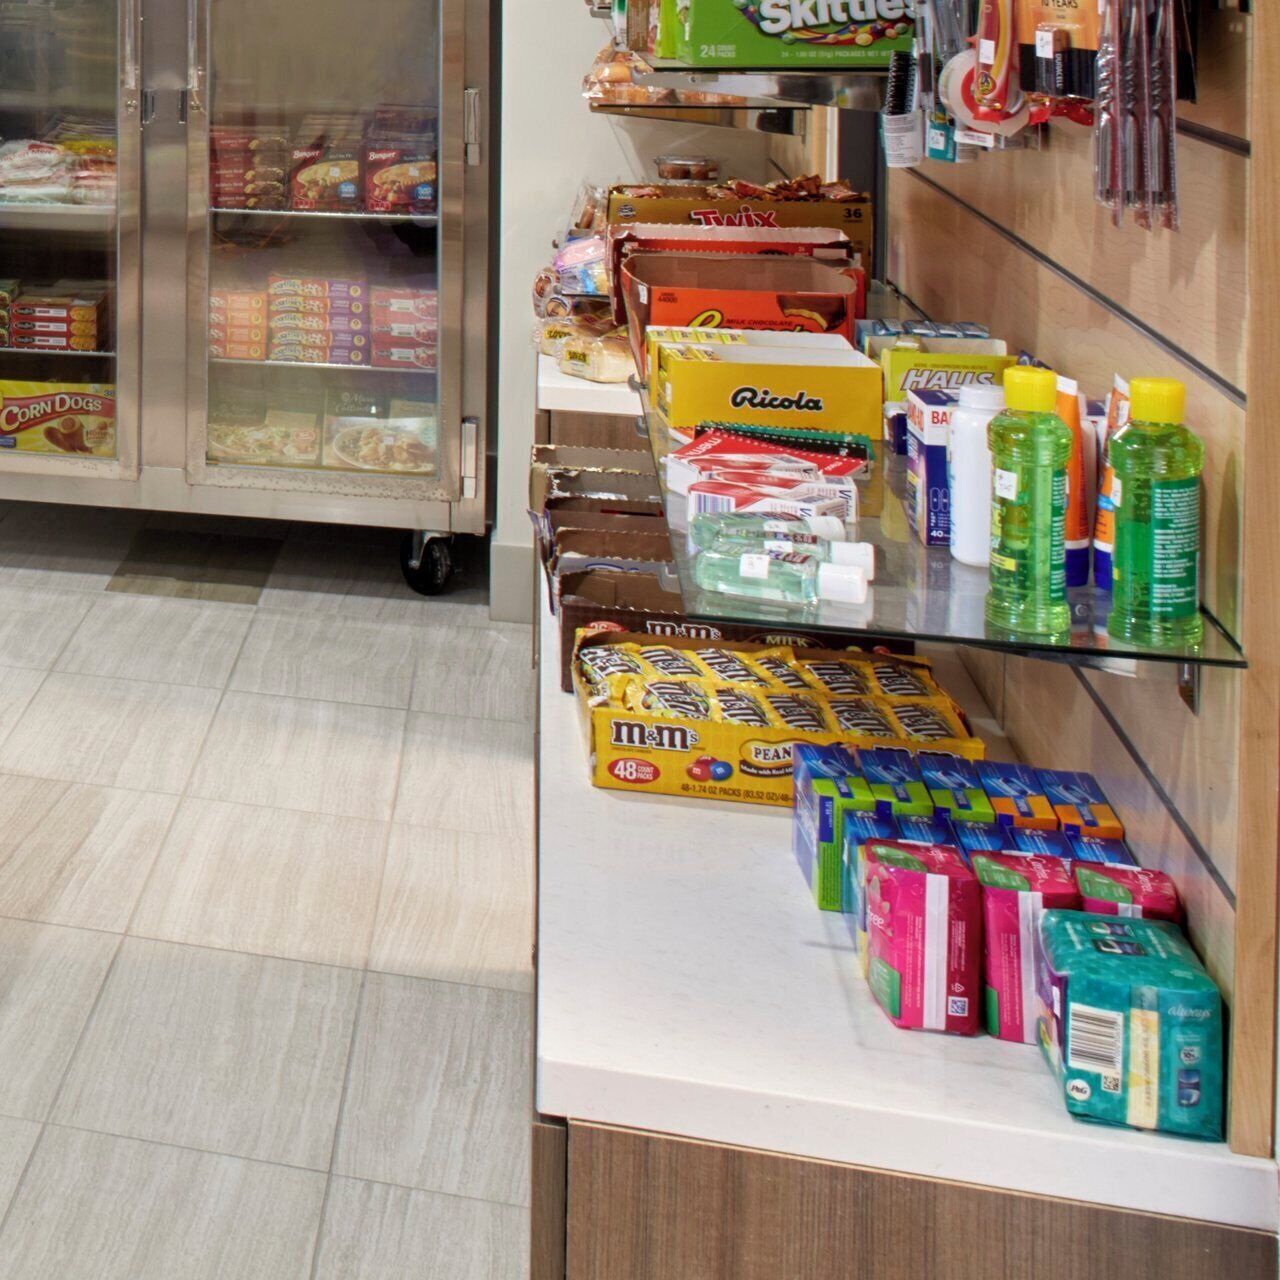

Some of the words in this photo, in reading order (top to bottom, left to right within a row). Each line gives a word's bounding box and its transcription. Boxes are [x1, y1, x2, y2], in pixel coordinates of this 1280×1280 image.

[700, 44, 716, 58] 24
[843, 208, 862, 219] 36
[901, 369, 995, 390] HALLS
[730, 387, 823, 411] Ricola
[0, 402, 53, 432] CORN
[55, 393, 102, 415] DOGS
[930, 529, 944, 538] 40
[611, 719, 699, 752] m&m's
[614, 761, 637, 780] 48
[637, 772, 653, 780] PACKS
[708, 786, 718, 796] OZ
[719, 787, 741, 797] PACKS
[1168, 1004, 1212, 1020] always
